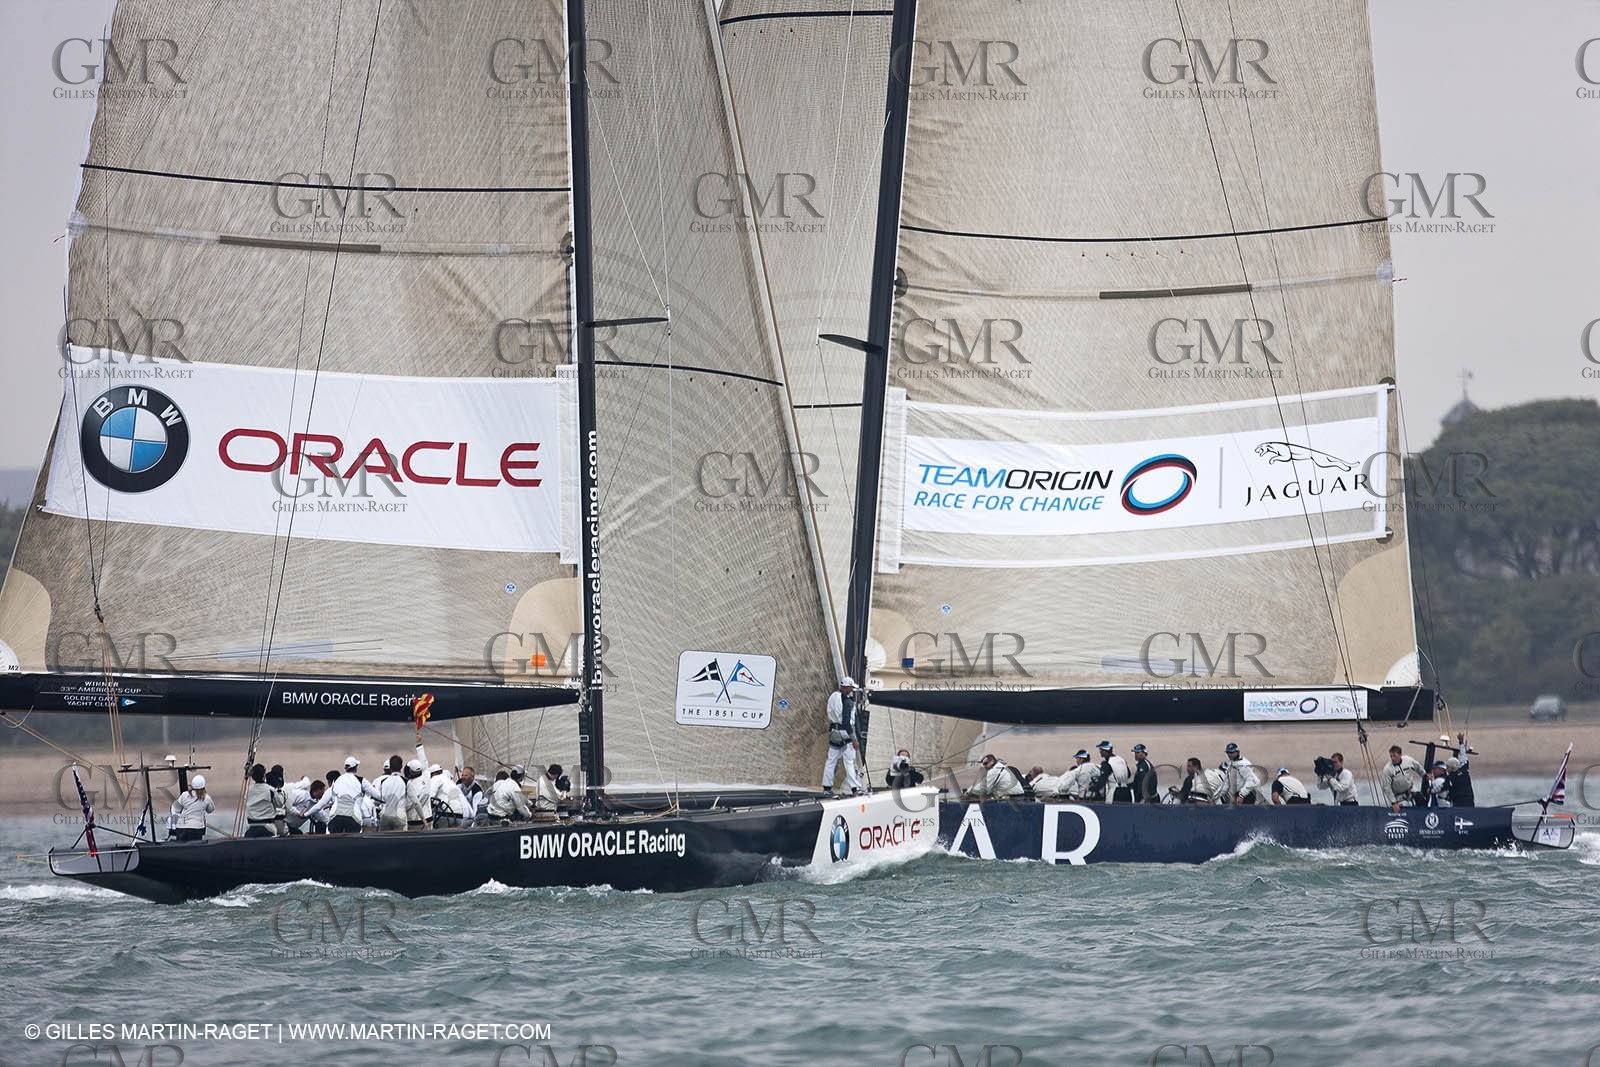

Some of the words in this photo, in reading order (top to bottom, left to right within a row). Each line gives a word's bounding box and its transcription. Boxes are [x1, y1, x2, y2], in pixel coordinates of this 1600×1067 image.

[93, 388, 182, 427] BMW
[218, 428, 543, 488] ORACLE
[919, 463, 1113, 491] TEAMORIGIN
[1245, 473, 1369, 507] JAGUAR
[913, 491, 968, 509] RACE
[972, 494, 1017, 512] FOR
[1019, 495, 1105, 512] CHANGE
[282, 692, 317, 705] BMW
[320, 692, 378, 706] ORACLE
[682, 708, 700, 716] THE
[709, 709, 733, 717] 1851
[742, 711, 763, 719] CUP
[520, 833, 565, 860] BMW
[567, 829, 635, 858] ORACLE
[638, 828, 686, 858] Racing
